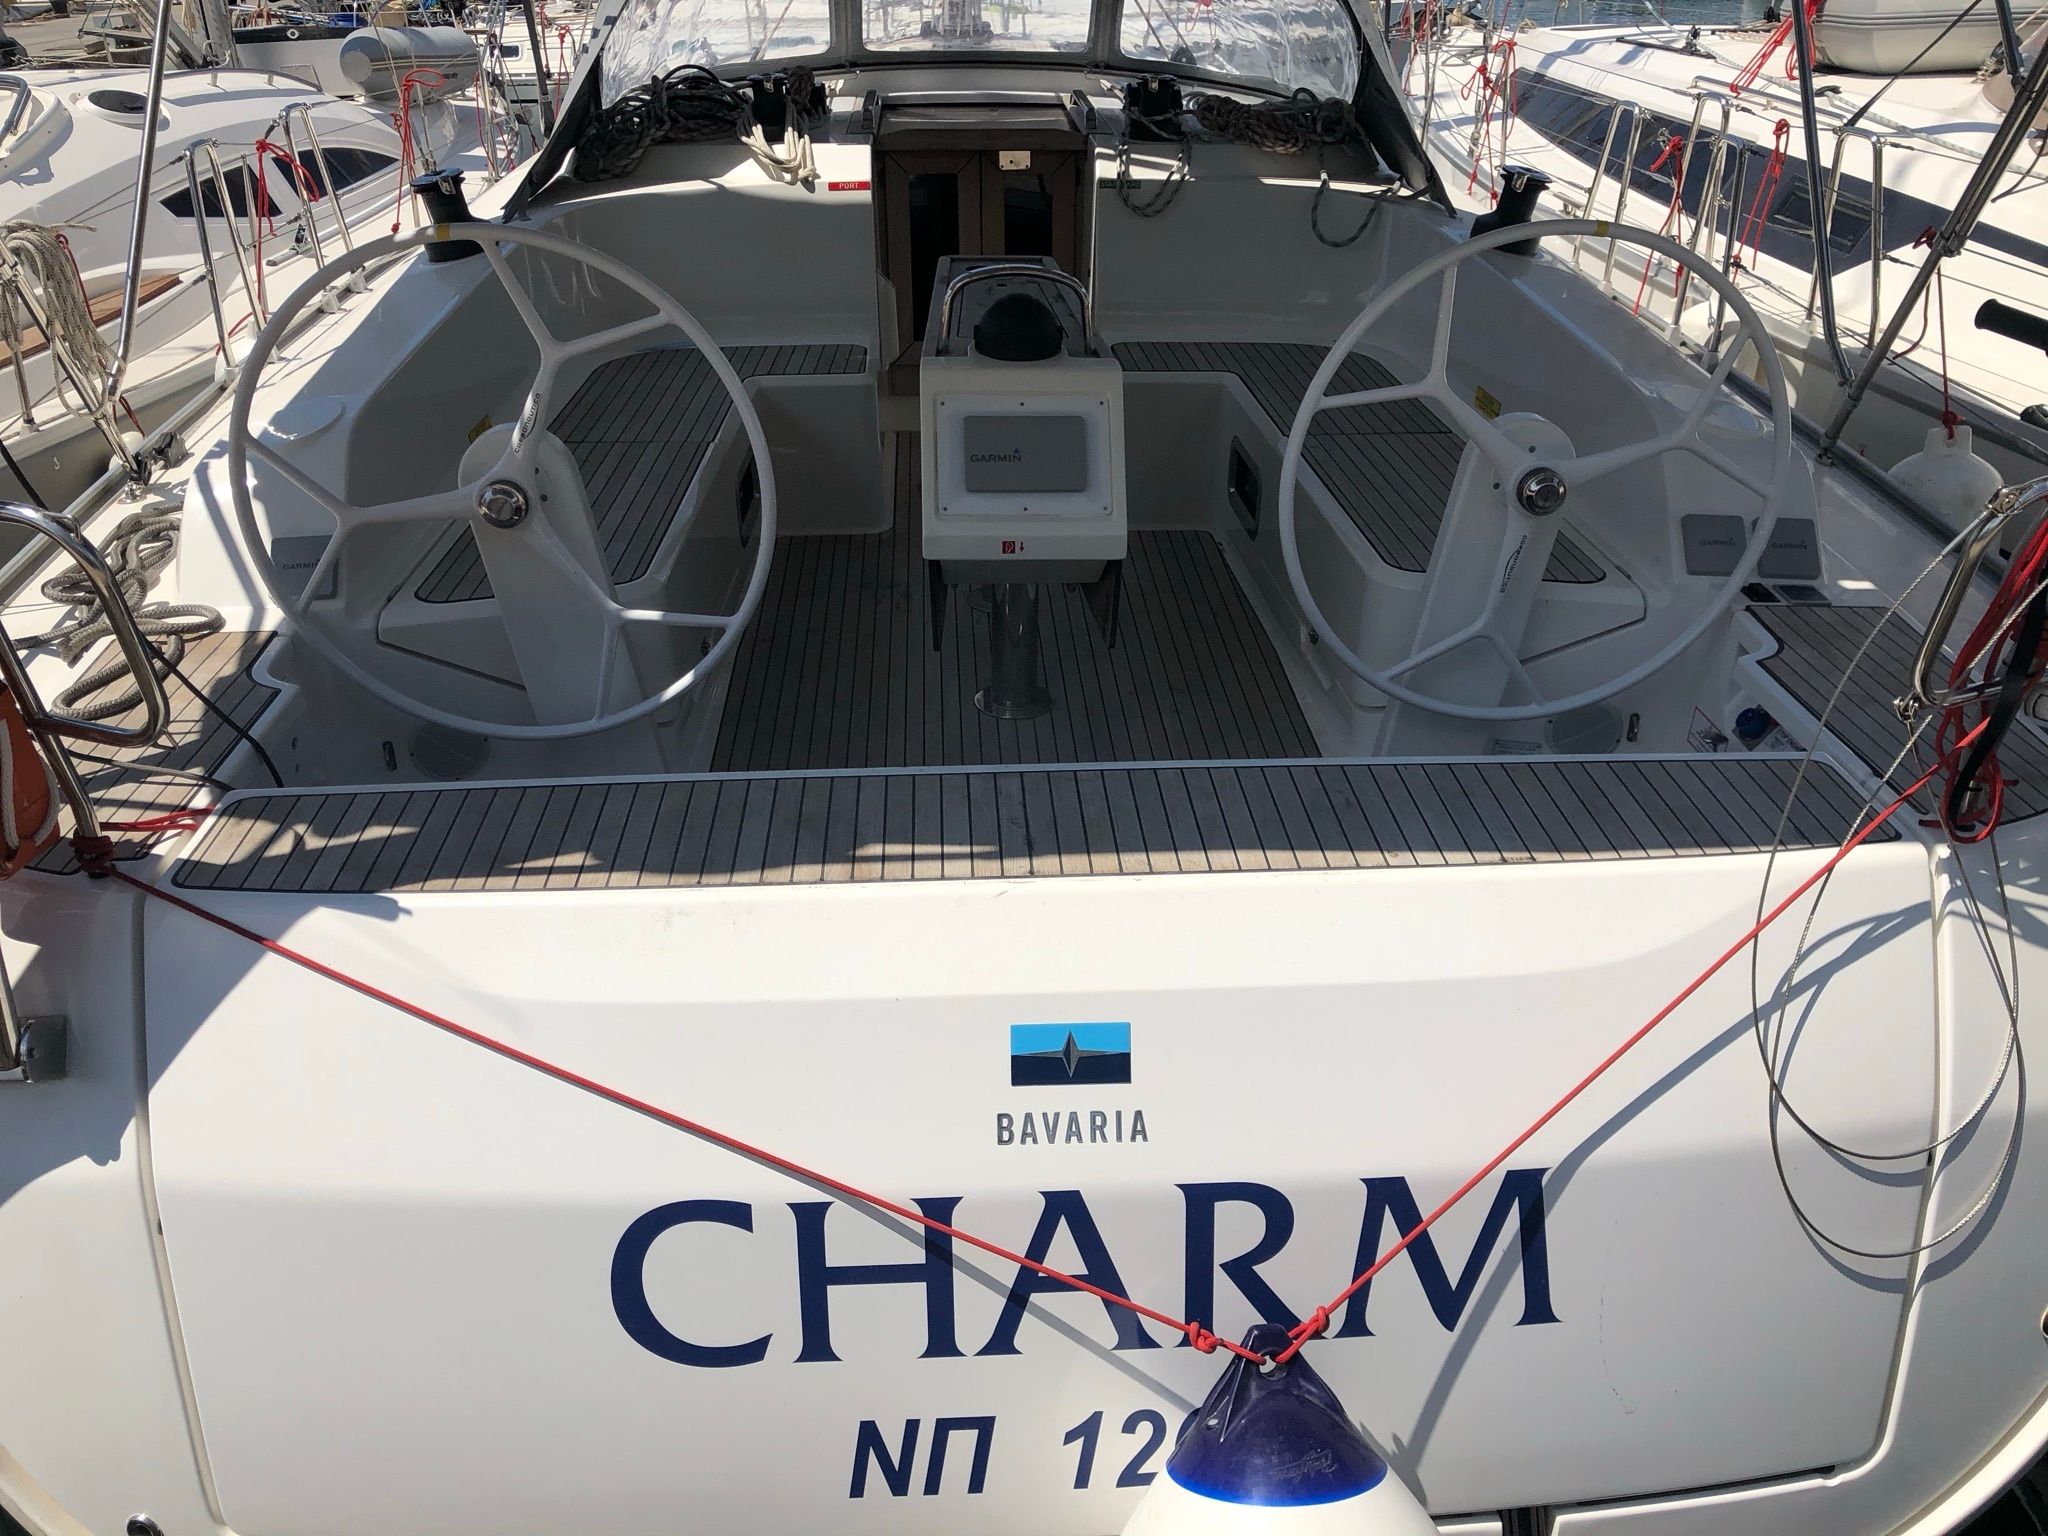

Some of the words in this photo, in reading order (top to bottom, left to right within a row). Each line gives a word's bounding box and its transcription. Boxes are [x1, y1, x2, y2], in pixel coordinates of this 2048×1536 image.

[970, 454, 1022, 463] GARMIN
[996, 1110, 1149, 1146] BAVARIA
[611, 1168, 1562, 1369] CHARM
[1062, 1407, 1202, 1490] 12
